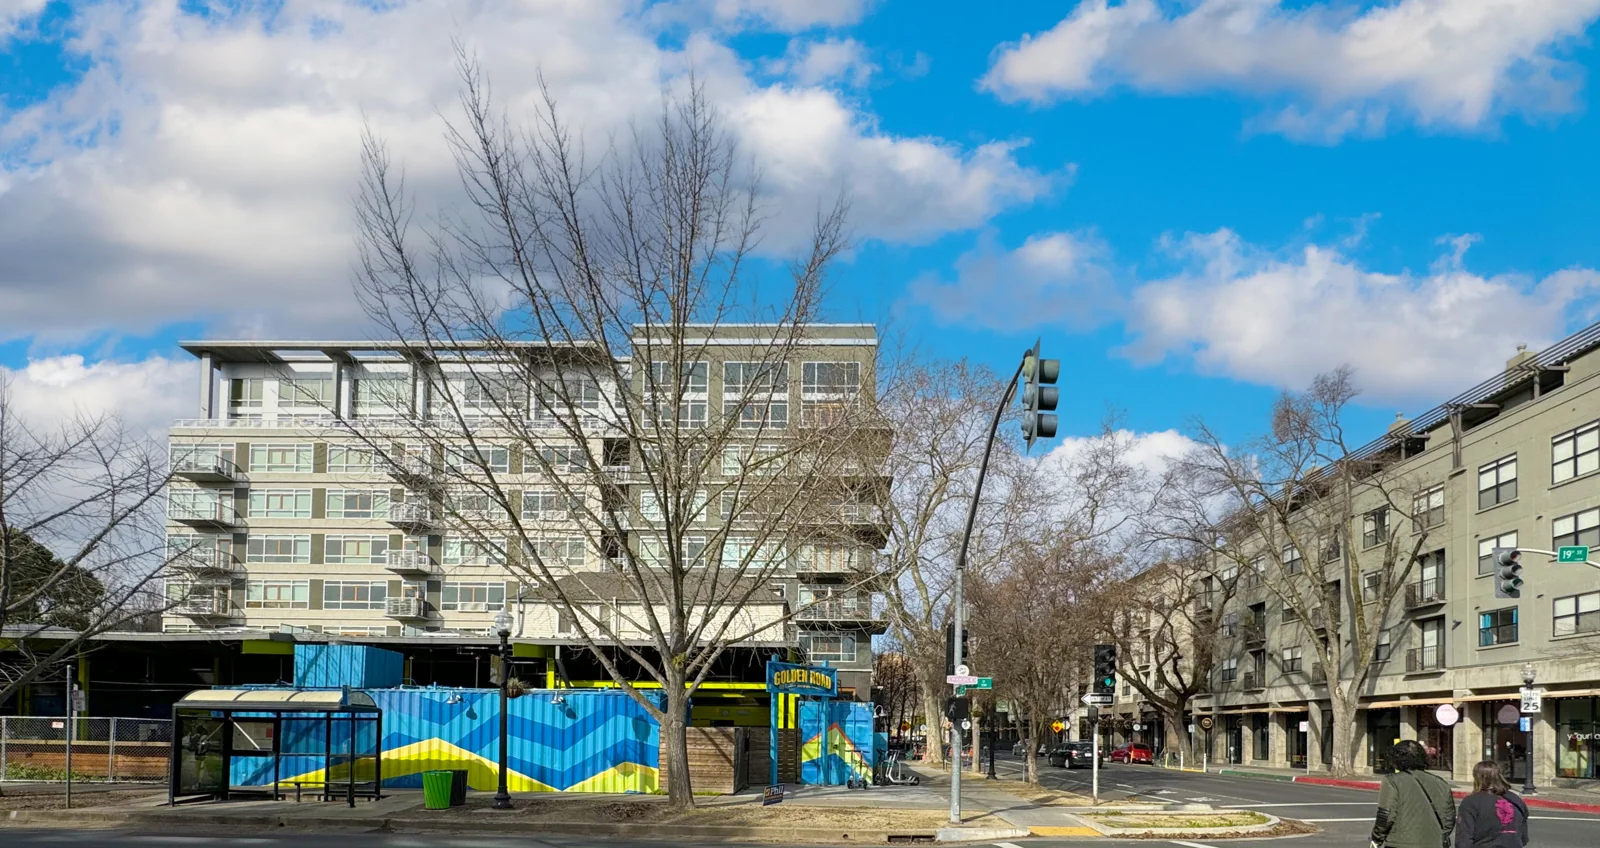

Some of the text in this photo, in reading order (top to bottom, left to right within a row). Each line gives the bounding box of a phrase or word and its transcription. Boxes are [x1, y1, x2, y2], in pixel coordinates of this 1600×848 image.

[774, 669, 832, 690] GOLDEN ROAD
[1523, 702, 1539, 711] 25
